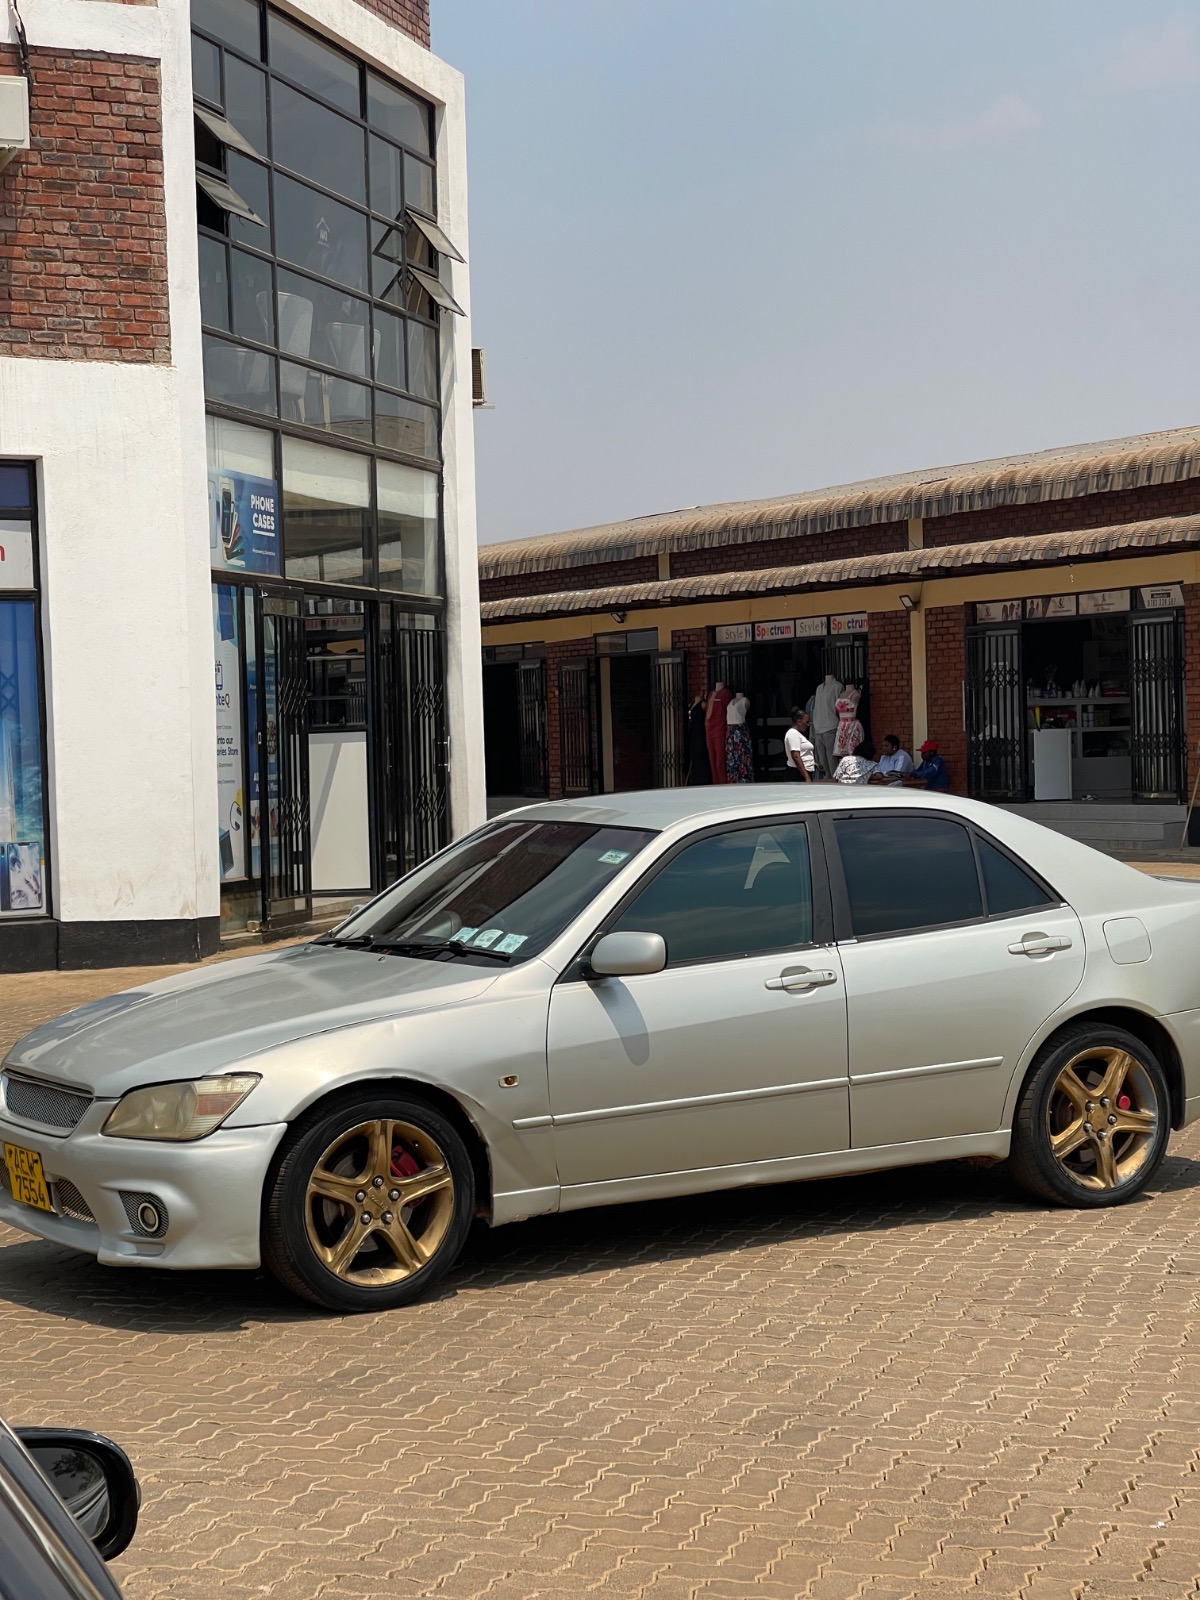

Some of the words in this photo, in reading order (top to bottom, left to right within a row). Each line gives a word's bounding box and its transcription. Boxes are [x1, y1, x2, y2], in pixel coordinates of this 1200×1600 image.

[250, 494, 274, 512] PHONE
[252, 512, 275, 530] CASES
[725, 627, 744, 641] Style
[756, 624, 792, 640] Spectrum
[799, 620, 820, 634] Style
[228, 747, 238, 756] Store
[15, 1174, 46, 1208] 7554
